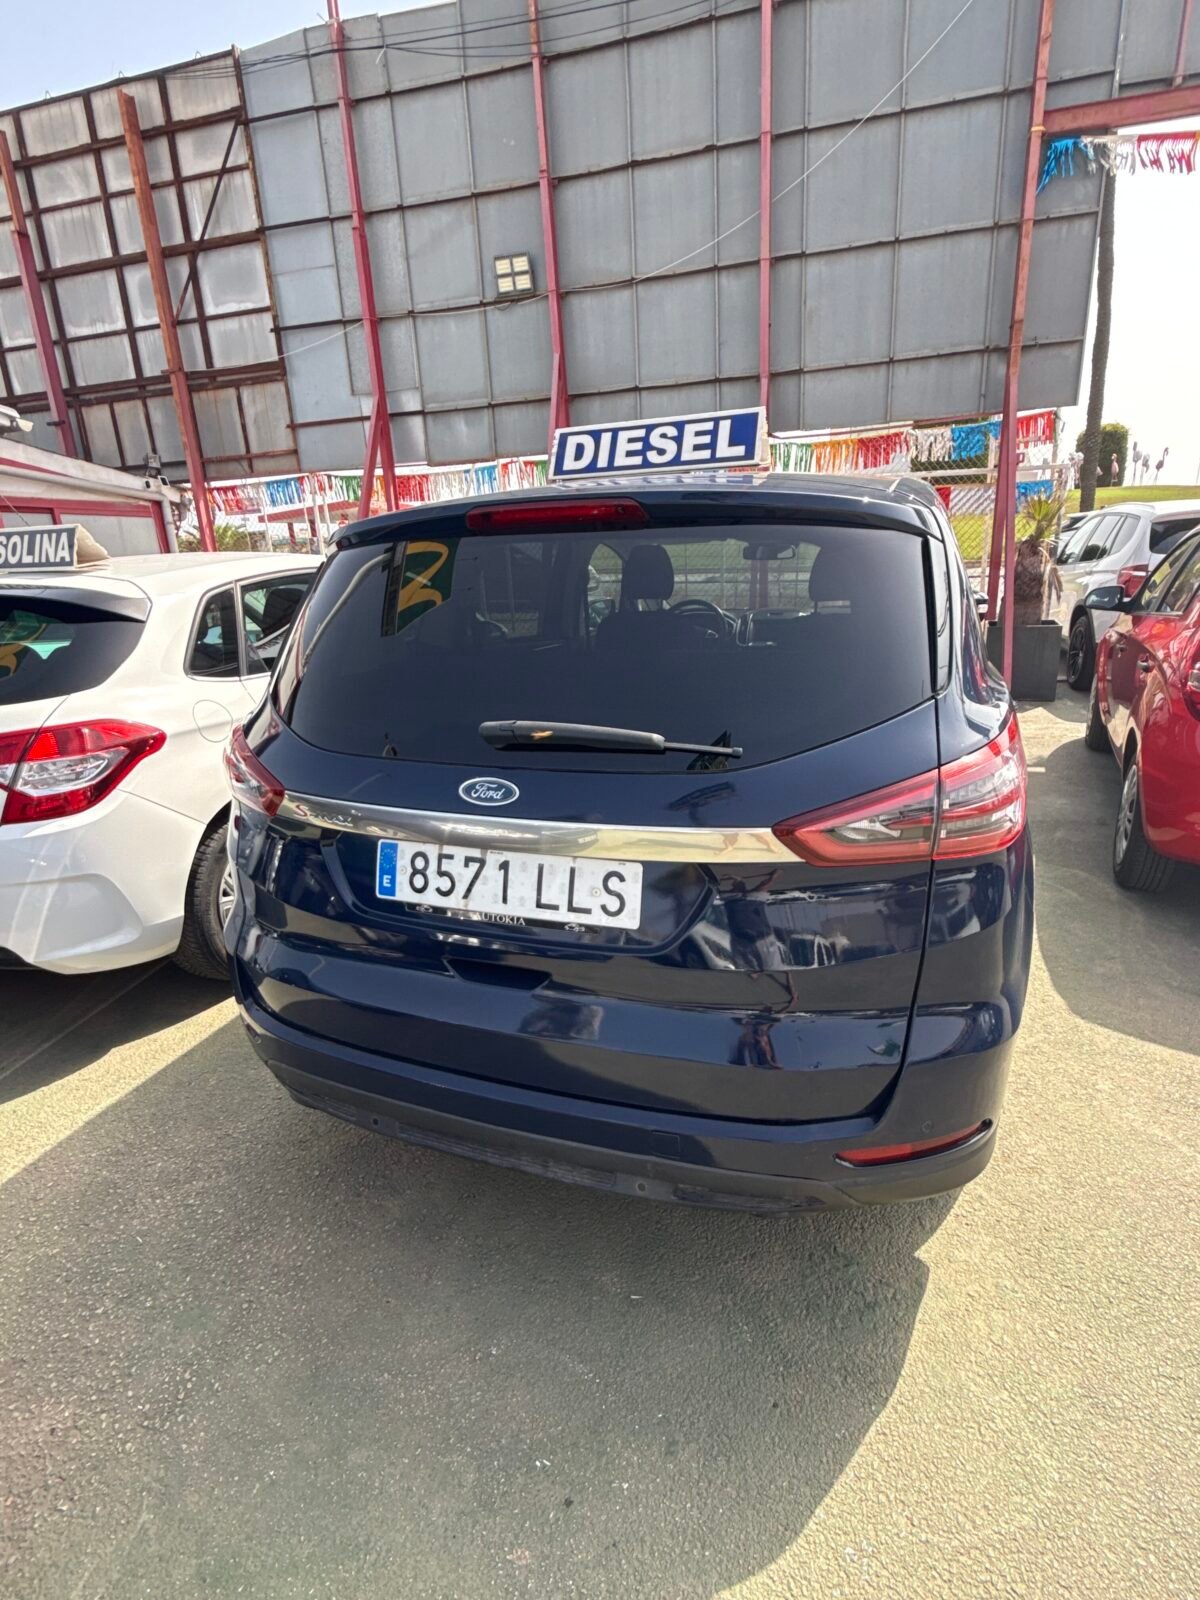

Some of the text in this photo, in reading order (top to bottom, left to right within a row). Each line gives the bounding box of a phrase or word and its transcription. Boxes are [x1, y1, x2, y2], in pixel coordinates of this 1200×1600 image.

[562, 419, 746, 471] DIESEL
[471, 782, 506, 800] Ford
[382, 851, 626, 917] E 8571 LLS
